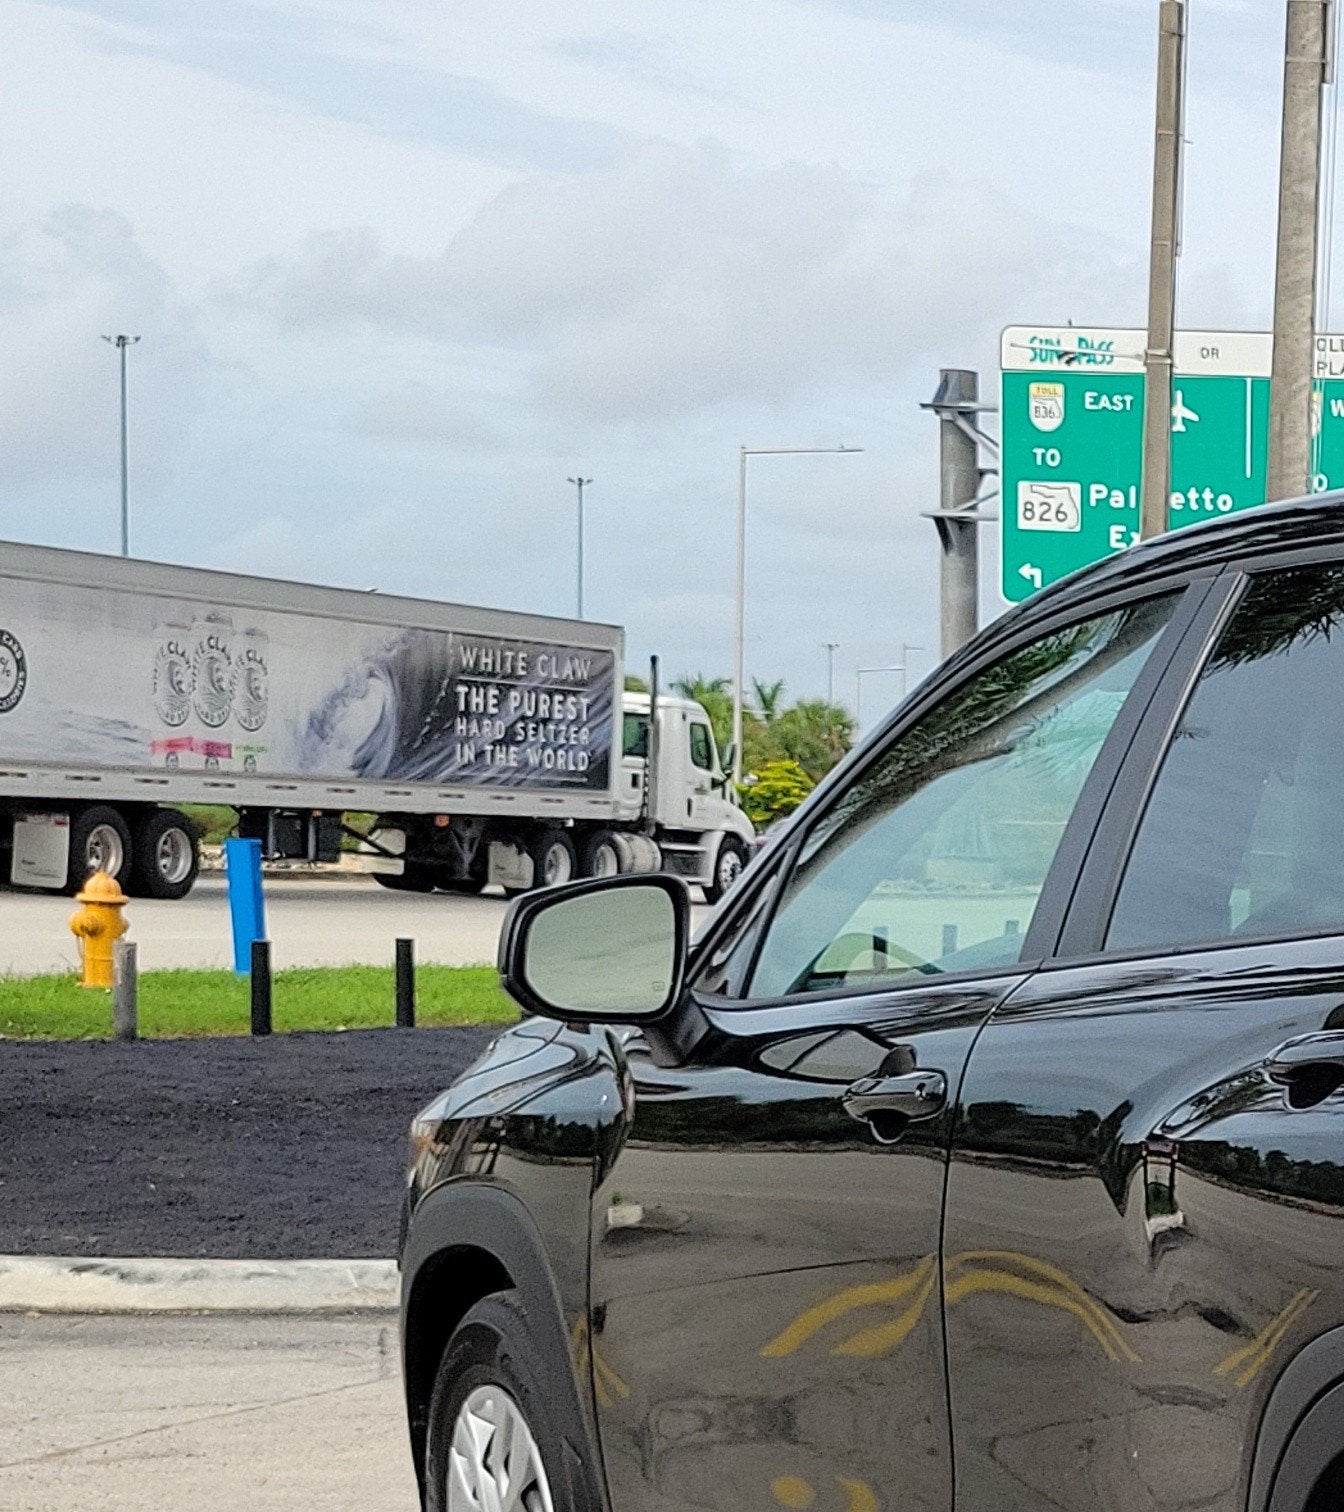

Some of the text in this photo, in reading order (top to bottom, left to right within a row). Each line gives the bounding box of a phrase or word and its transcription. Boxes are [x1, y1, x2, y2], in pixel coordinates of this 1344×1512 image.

[1200, 347, 1220, 359] OR
[1035, 386, 1059, 395] TOLL
[1084, 391, 1134, 411] EAST
[1032, 448, 1061, 467] TO
[1089, 483, 1234, 512] Paletto
[1023, 501, 1068, 522] 826
[459, 646, 591, 680] WHITE CLAW
[455, 684, 591, 722] THE PUREST
[456, 717, 590, 746] HARD SELTZER
[456, 742, 590, 771] IN THE WORLD
